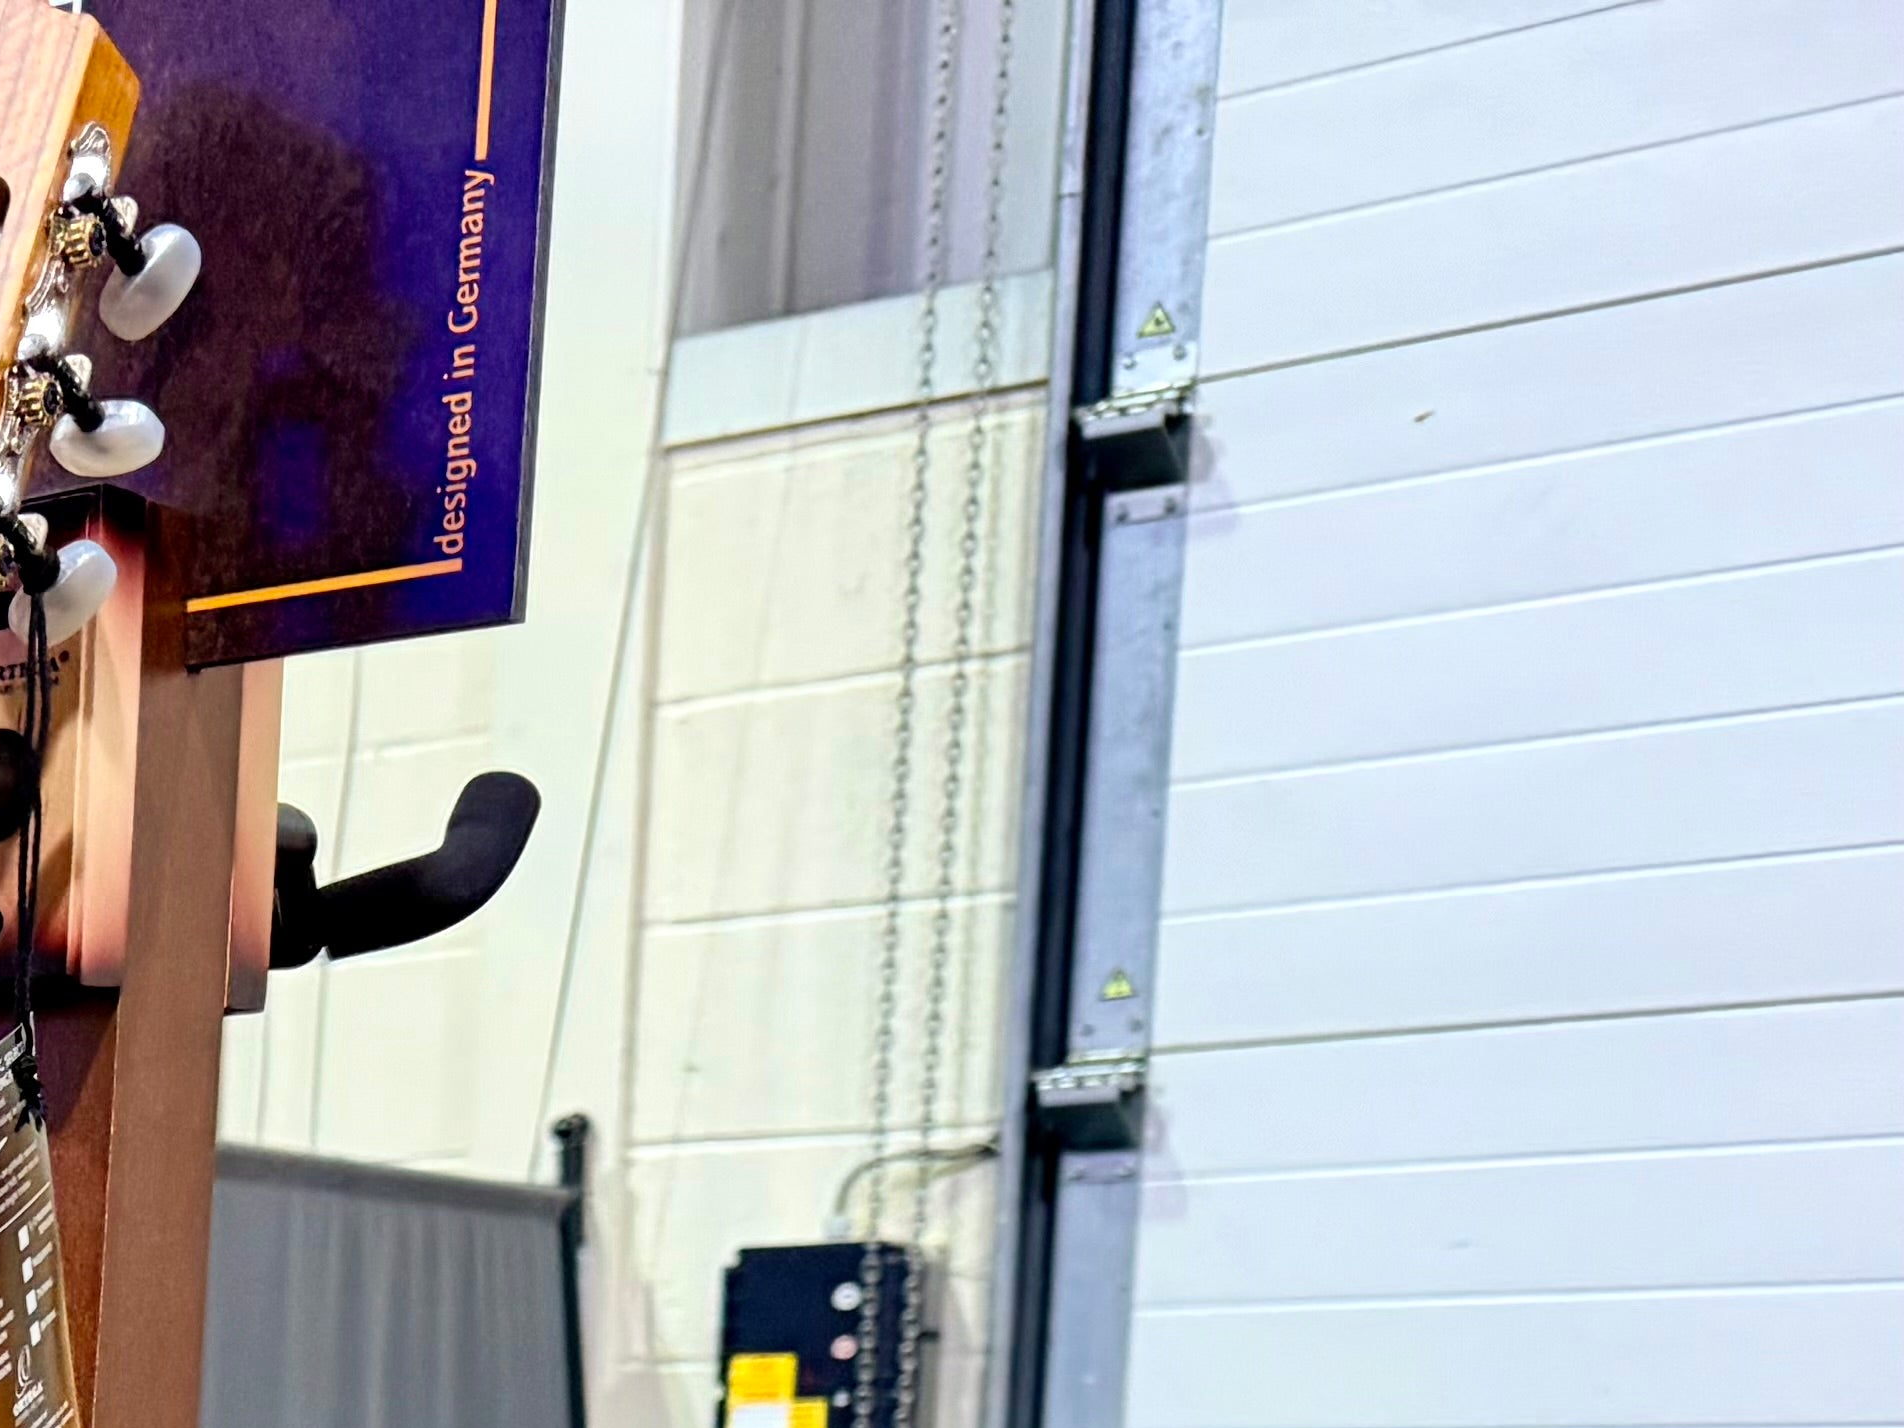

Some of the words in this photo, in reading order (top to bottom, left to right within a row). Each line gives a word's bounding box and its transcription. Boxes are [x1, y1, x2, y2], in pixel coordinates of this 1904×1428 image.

[448, 169, 495, 335] Germany
[443, 343, 476, 380] in
[433, 390, 478, 556] designed
